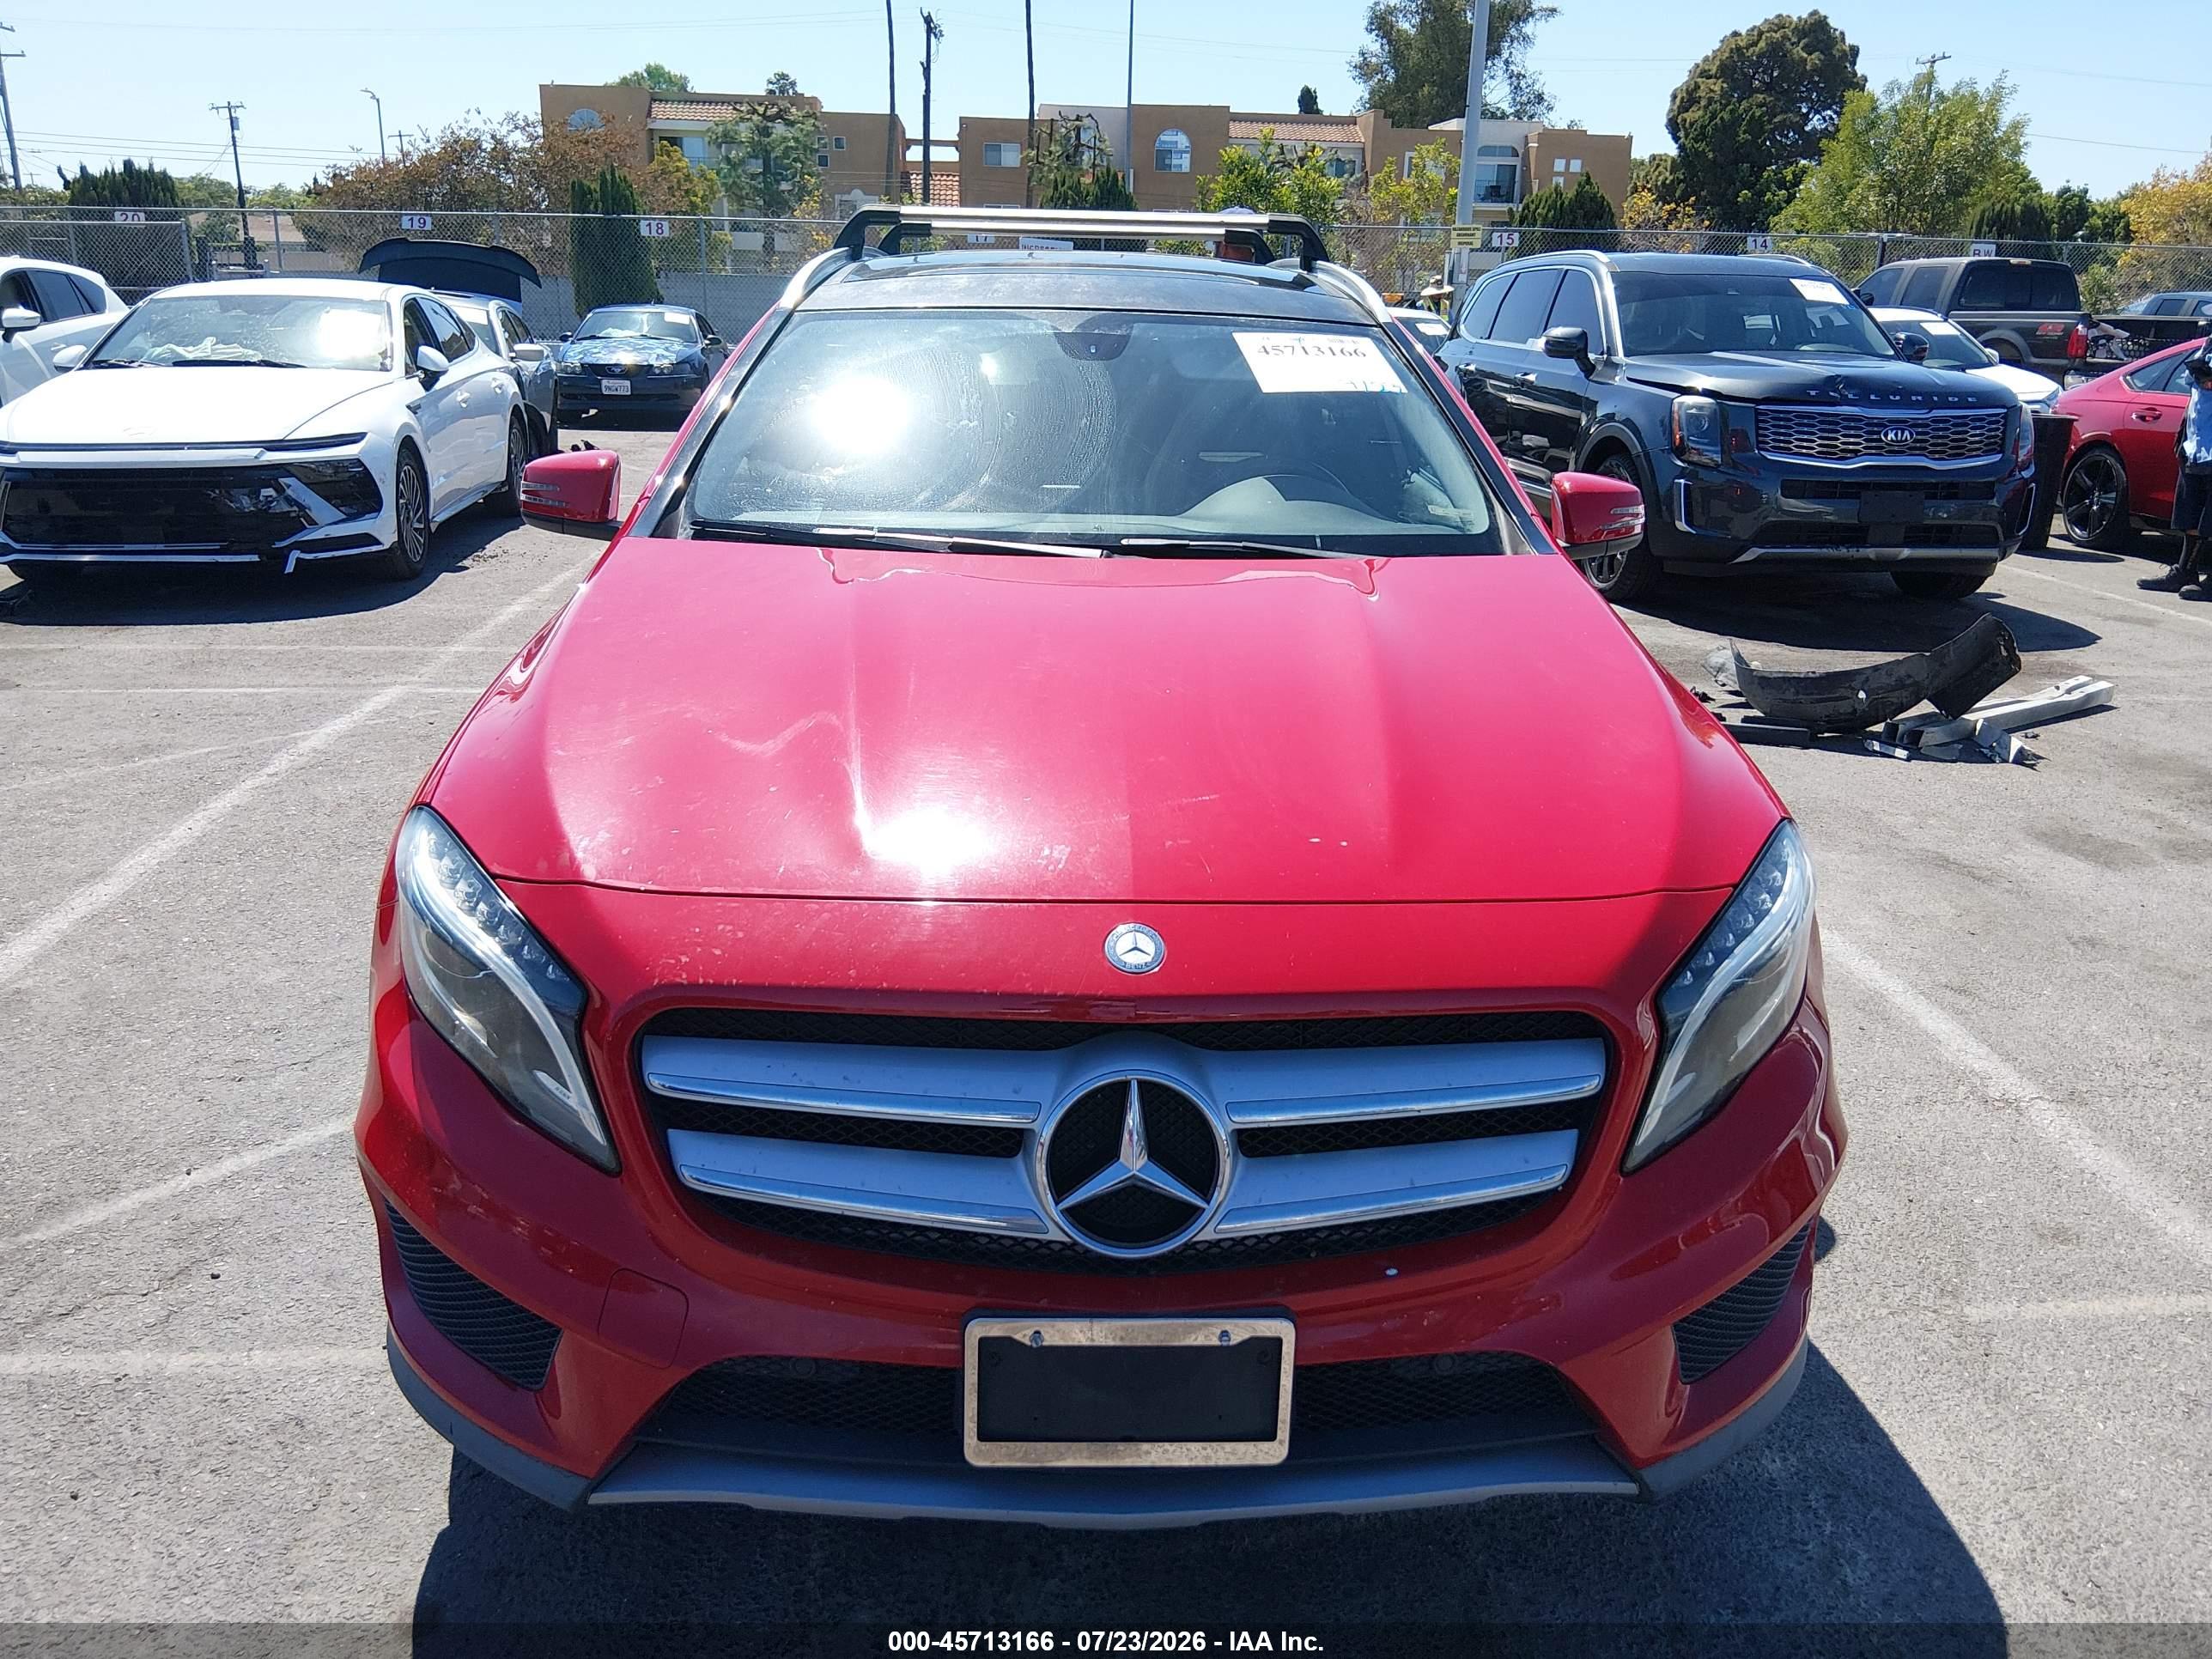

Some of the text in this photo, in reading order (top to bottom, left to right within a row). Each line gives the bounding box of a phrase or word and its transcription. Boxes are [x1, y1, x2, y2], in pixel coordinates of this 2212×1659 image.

[408, 216, 427, 228] 19
[646, 222, 664, 235] 18
[1497, 233, 1515, 246] 15
[1752, 238, 1768, 250] 14
[1257, 344, 1367, 358] 45713166
[1887, 429, 1911, 441] KIA
